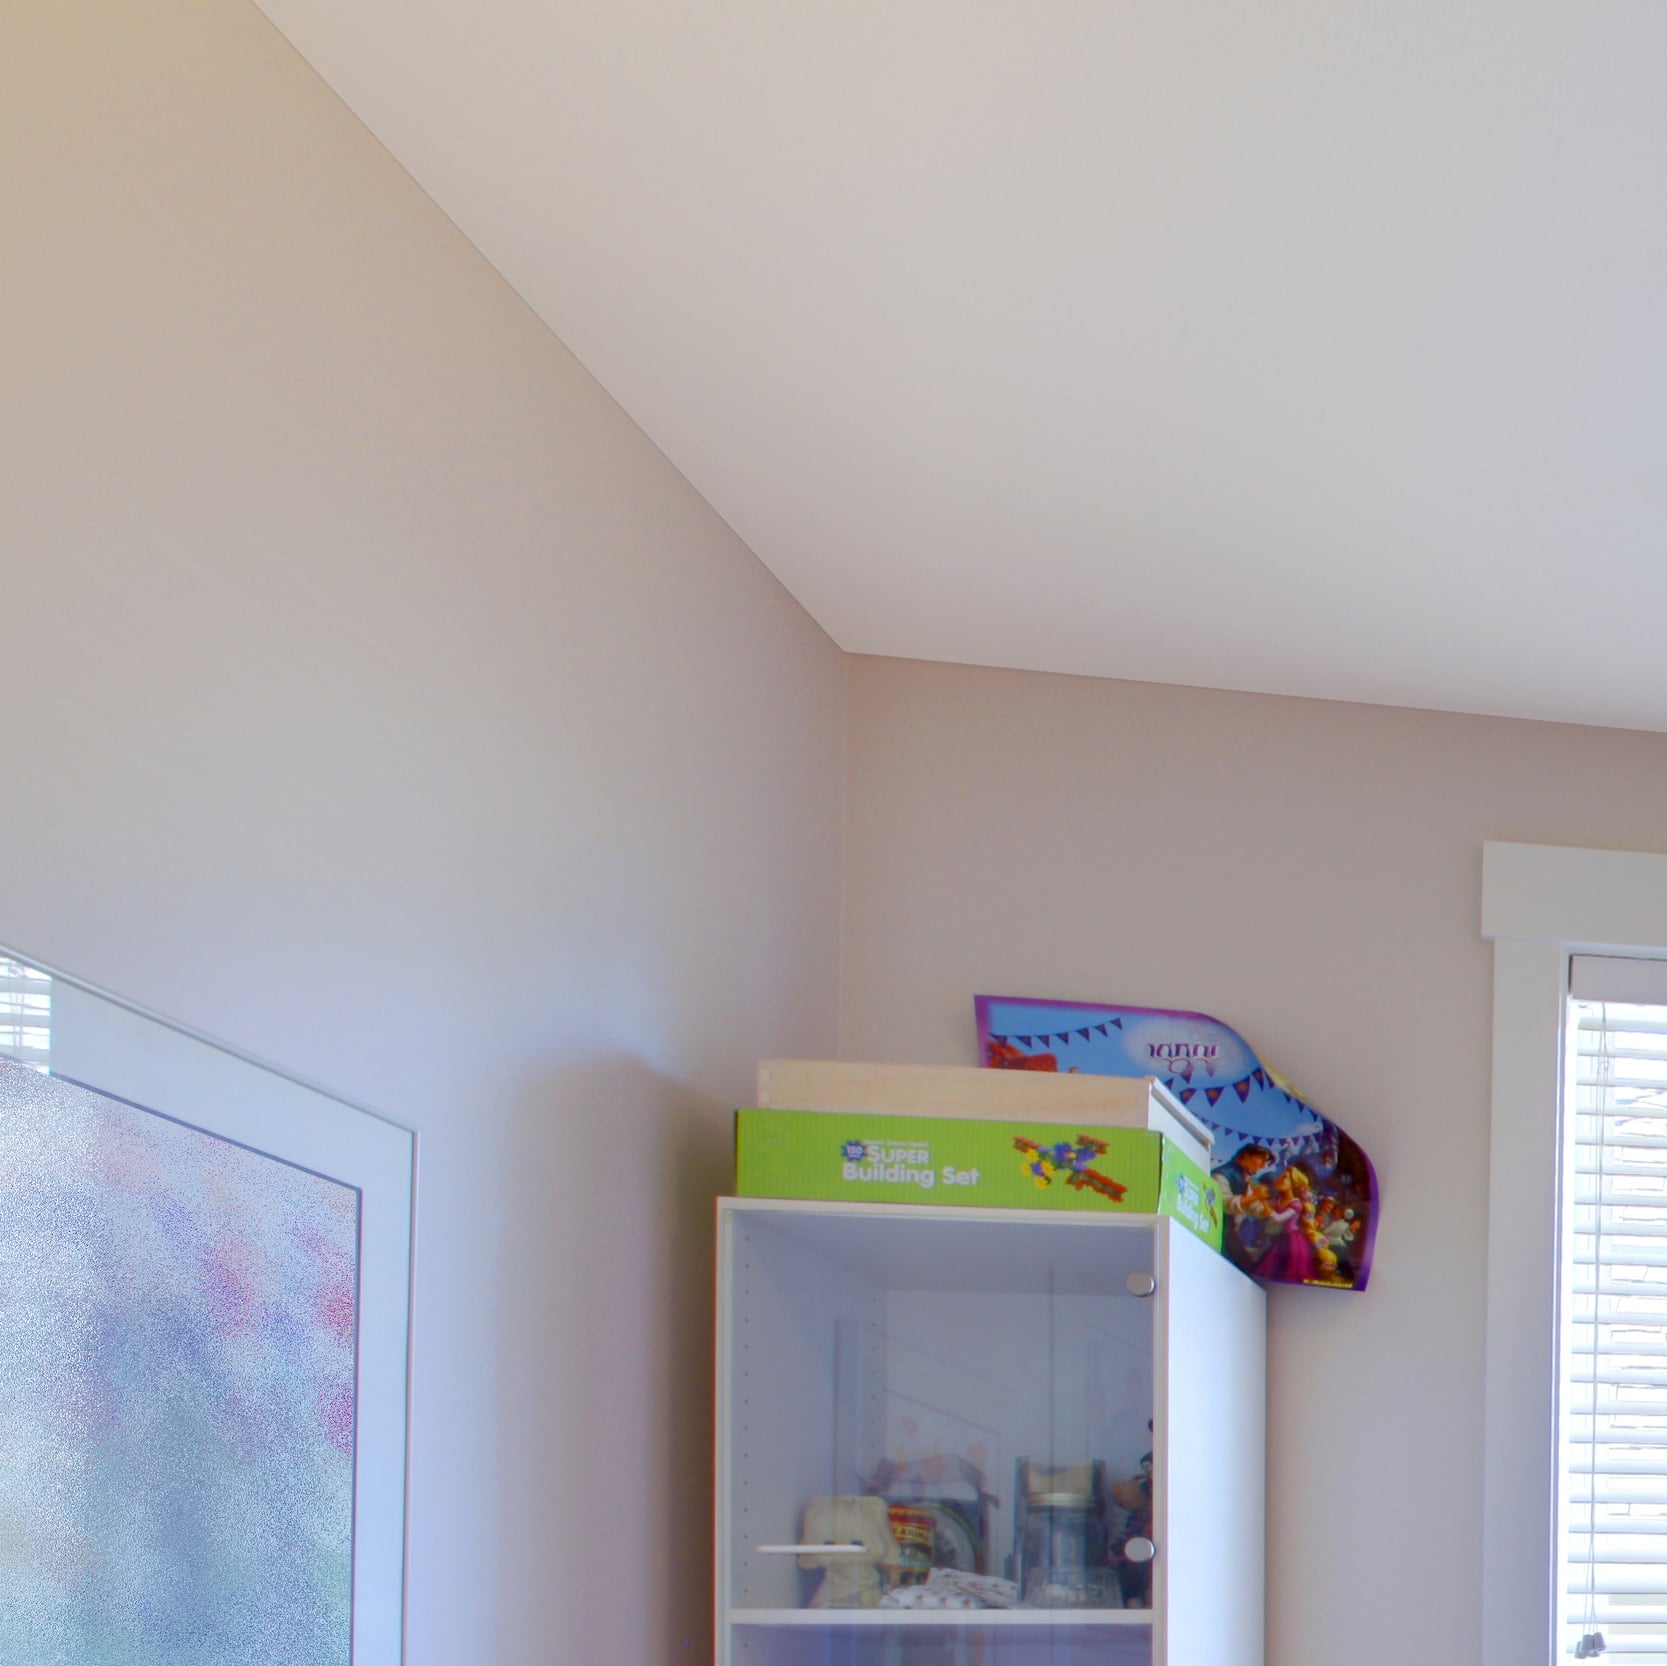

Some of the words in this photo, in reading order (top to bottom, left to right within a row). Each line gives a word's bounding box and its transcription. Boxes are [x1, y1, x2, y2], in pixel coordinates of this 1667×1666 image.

[867, 1146, 930, 1164] SUPER
[843, 1163, 935, 1188] Building
[942, 1166, 980, 1186] Set
